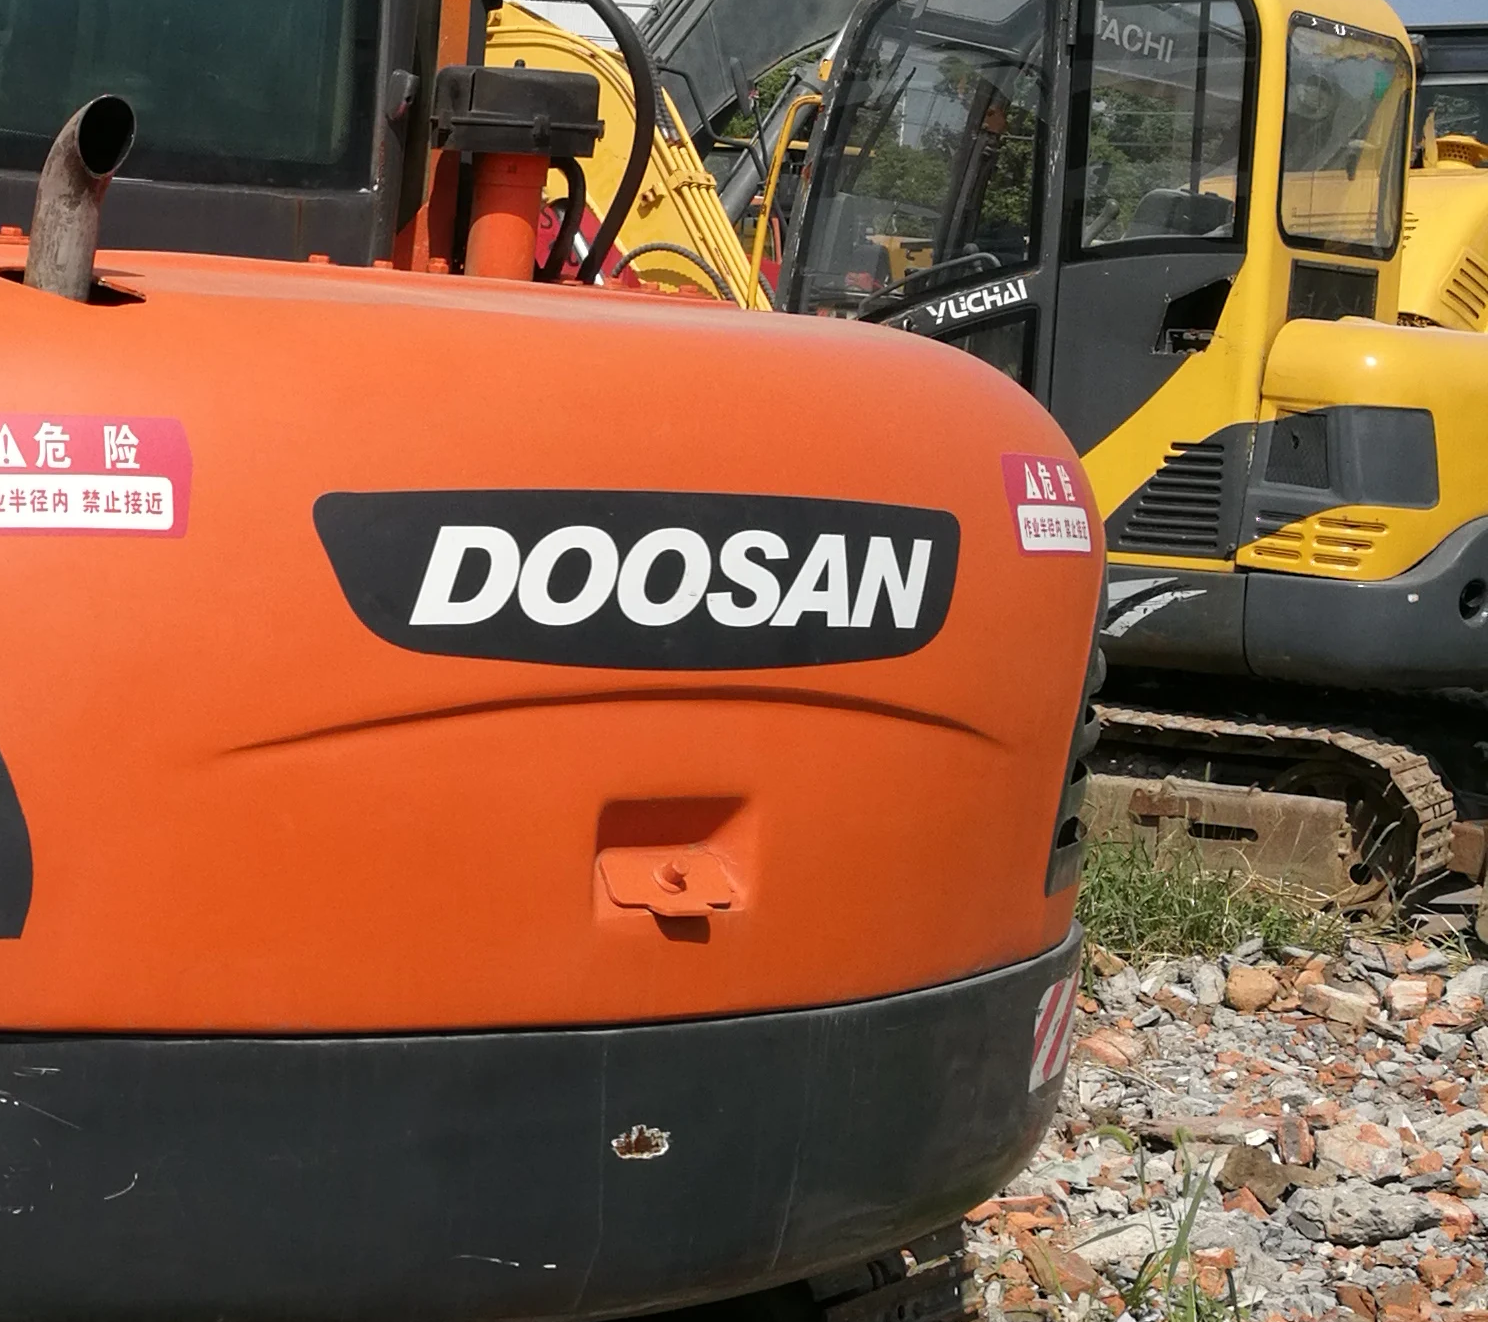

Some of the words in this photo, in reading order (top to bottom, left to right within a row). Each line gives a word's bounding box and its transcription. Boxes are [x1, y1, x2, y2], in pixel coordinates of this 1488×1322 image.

[925, 279, 1028, 326] YUCHAI
[33, 422, 141, 469] 危险
[81, 489, 165, 516] 禁止接近
[408, 525, 933, 629] DOOSAN
